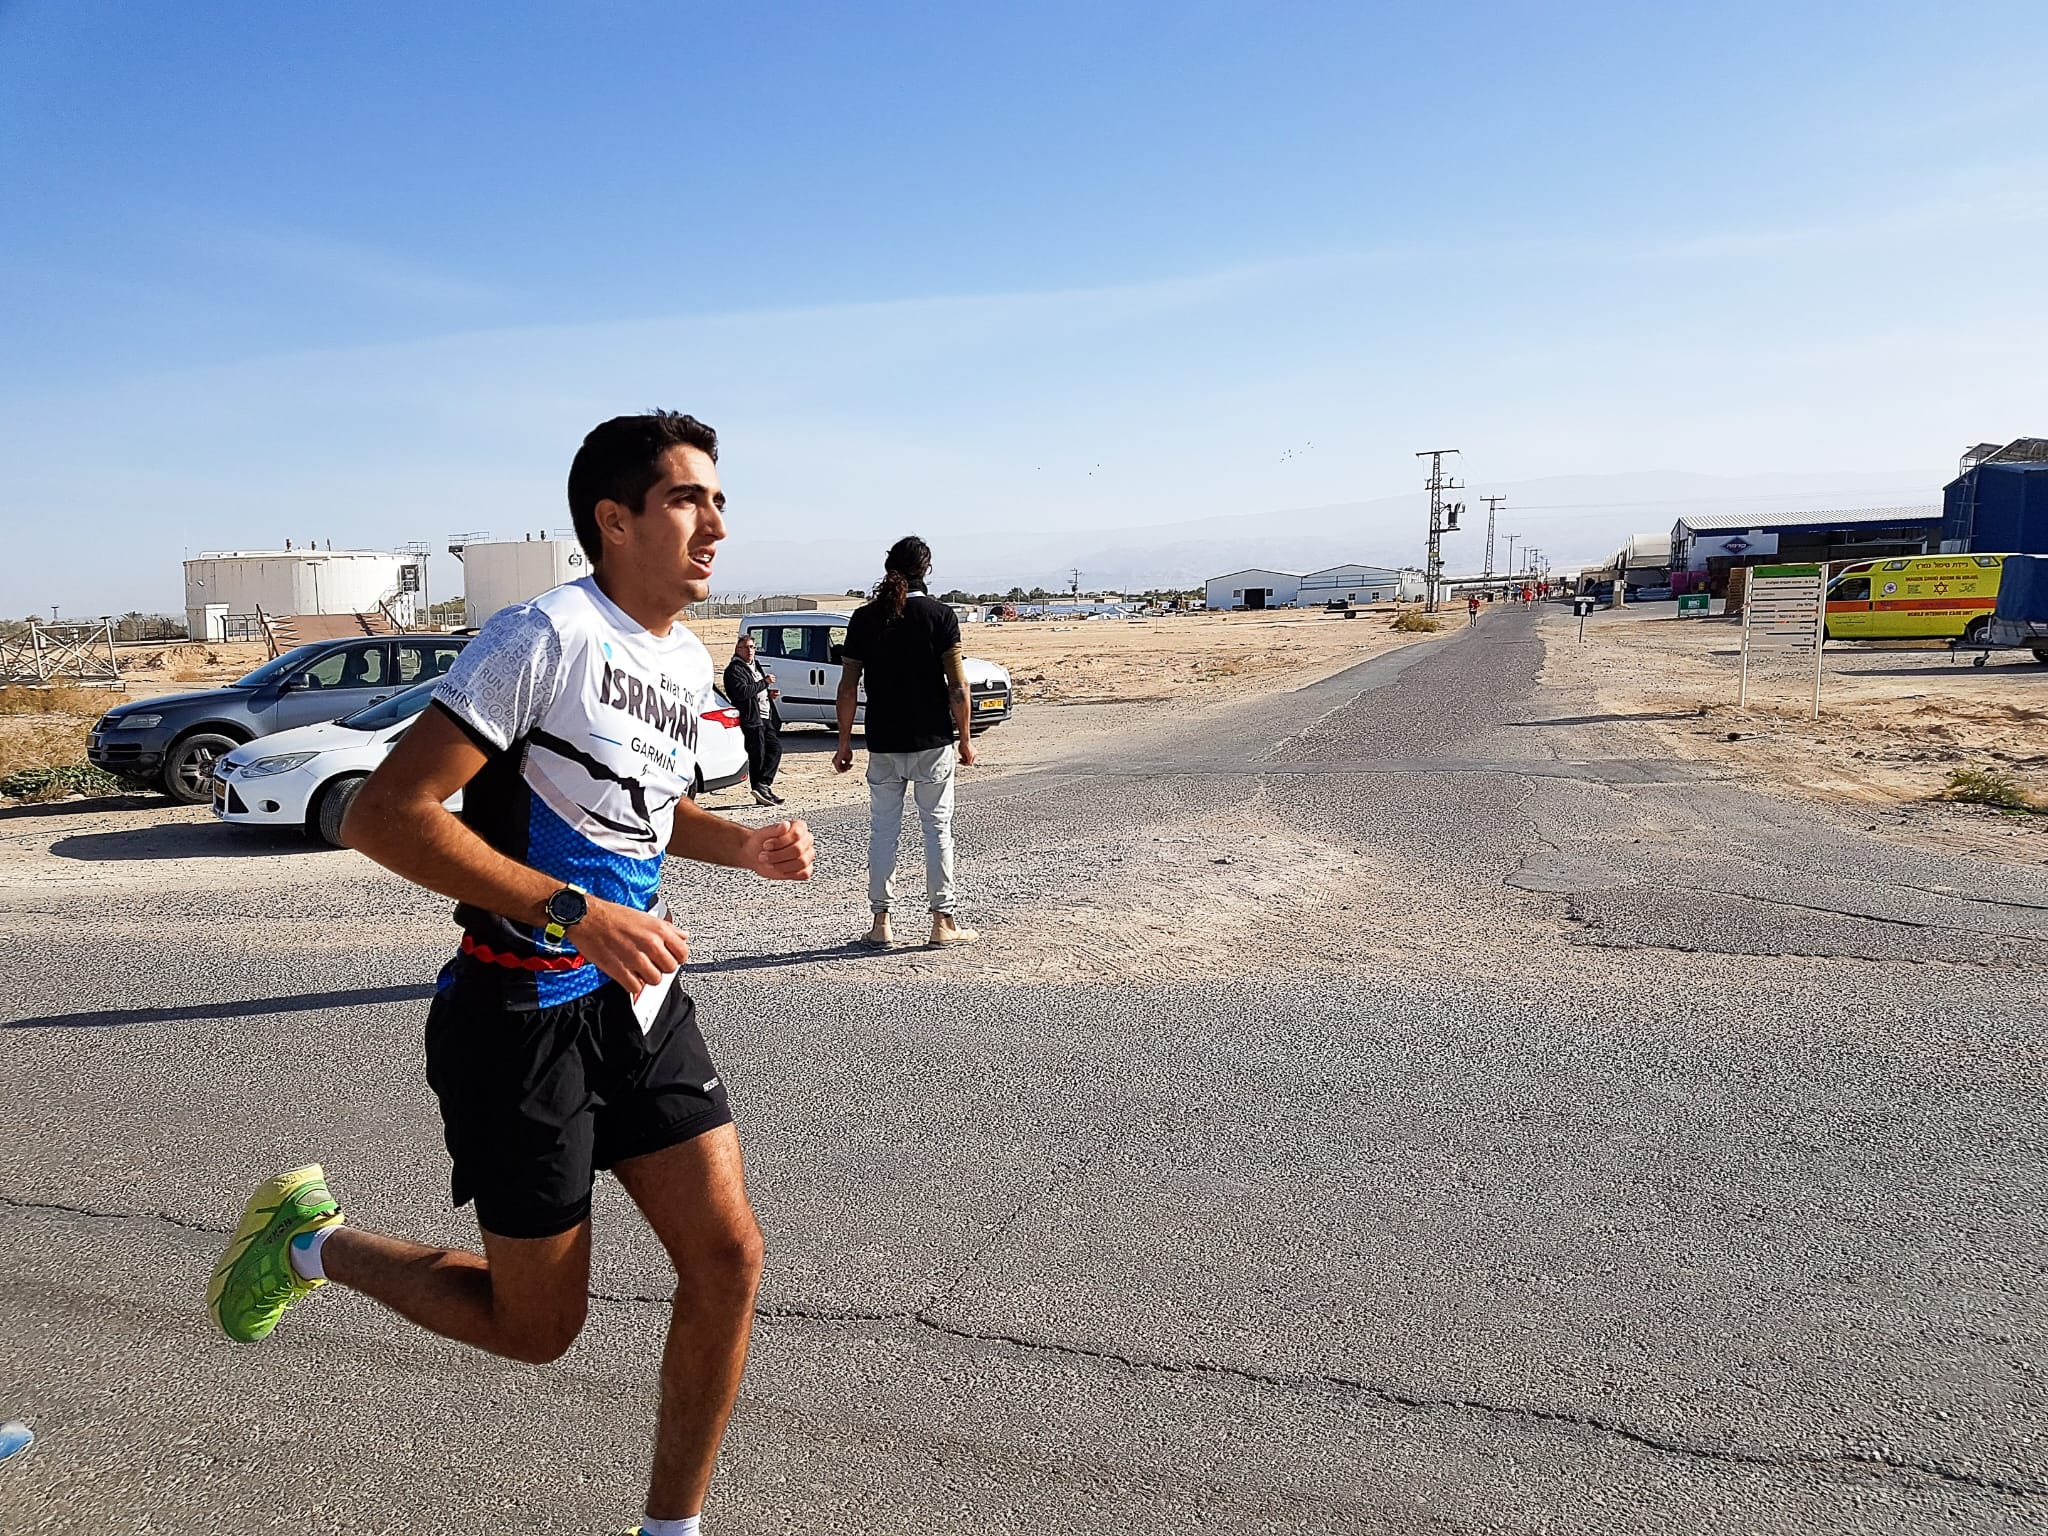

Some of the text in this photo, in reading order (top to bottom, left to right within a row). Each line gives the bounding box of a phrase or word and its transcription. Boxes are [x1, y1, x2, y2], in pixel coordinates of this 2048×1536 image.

[436, 680, 472, 708] RMIN
[479, 667, 505, 692] RUN
[599, 661, 698, 754] ISRAMAN
[631, 737, 677, 774] GARMIN
